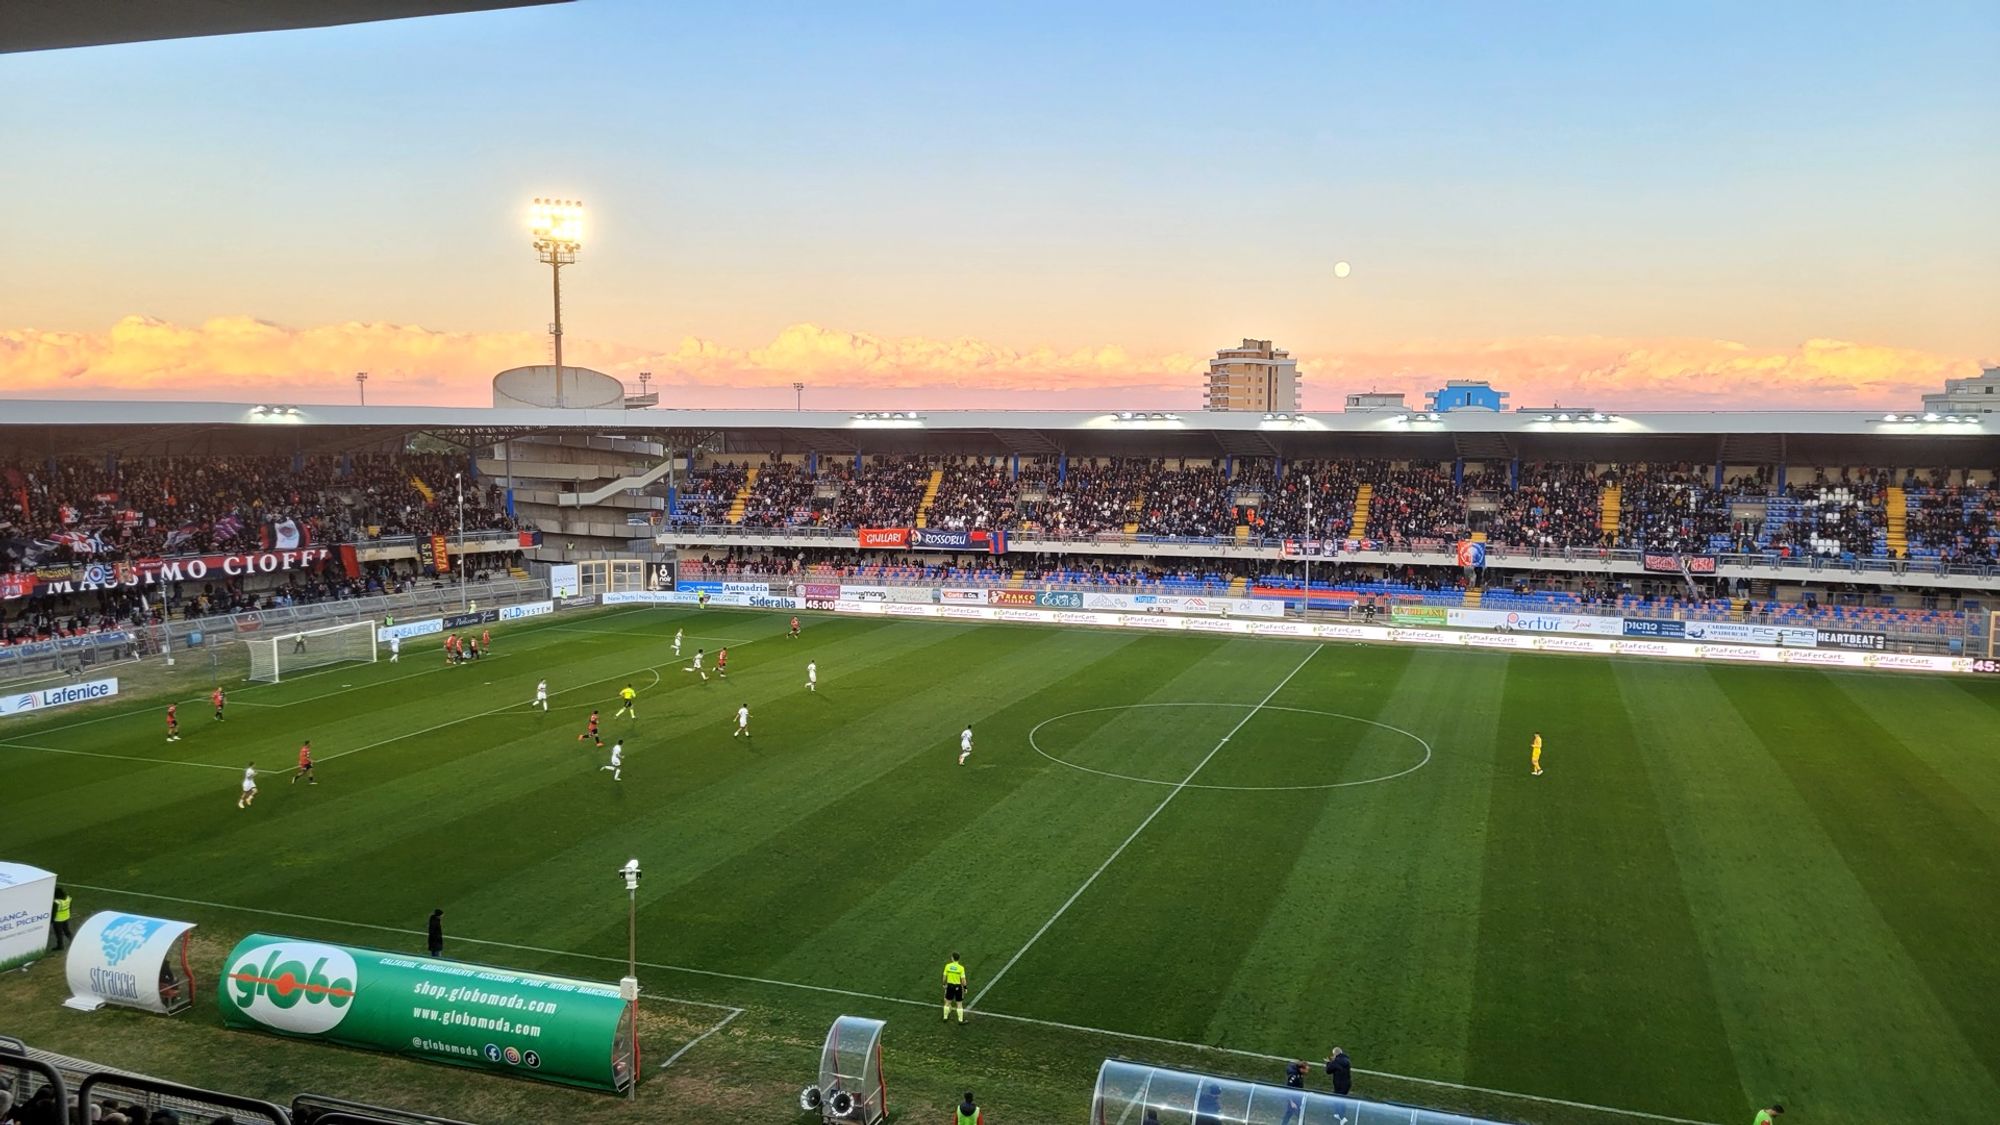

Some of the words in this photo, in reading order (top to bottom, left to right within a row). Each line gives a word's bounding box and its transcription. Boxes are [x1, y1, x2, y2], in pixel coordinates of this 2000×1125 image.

[866, 533, 902, 543] GIULLARI
[925, 534, 966, 545] ROSSOBLU
[434, 537, 447, 570] PIAZZA
[724, 584, 768, 592] Autoadria
[750, 596, 796, 608] Sideralba
[807, 600, 834, 610] 45:00
[1507, 612, 1560, 630] Pertur
[1818, 632, 1875, 644] HEARTBEAT
[43, 683, 109, 705] Lafenice
[16, 912, 49, 927] PICENO
[90, 967, 138, 999] straccia
[235, 950, 353, 1009] globo
[380, 958, 418, 969] CALZATURE
[420, 963, 475, 977] ABBIGLIAMENTO
[478, 972, 518, 984] ACCESSORI
[521, 978, 545, 988] SPORT
[549, 982, 575, 992] INTIMO
[414, 981, 558, 1014] shop.globomoda.com
[413, 1007, 541, 1037] www.globomoda.com
[412, 1036, 478, 1057] @globomoda
